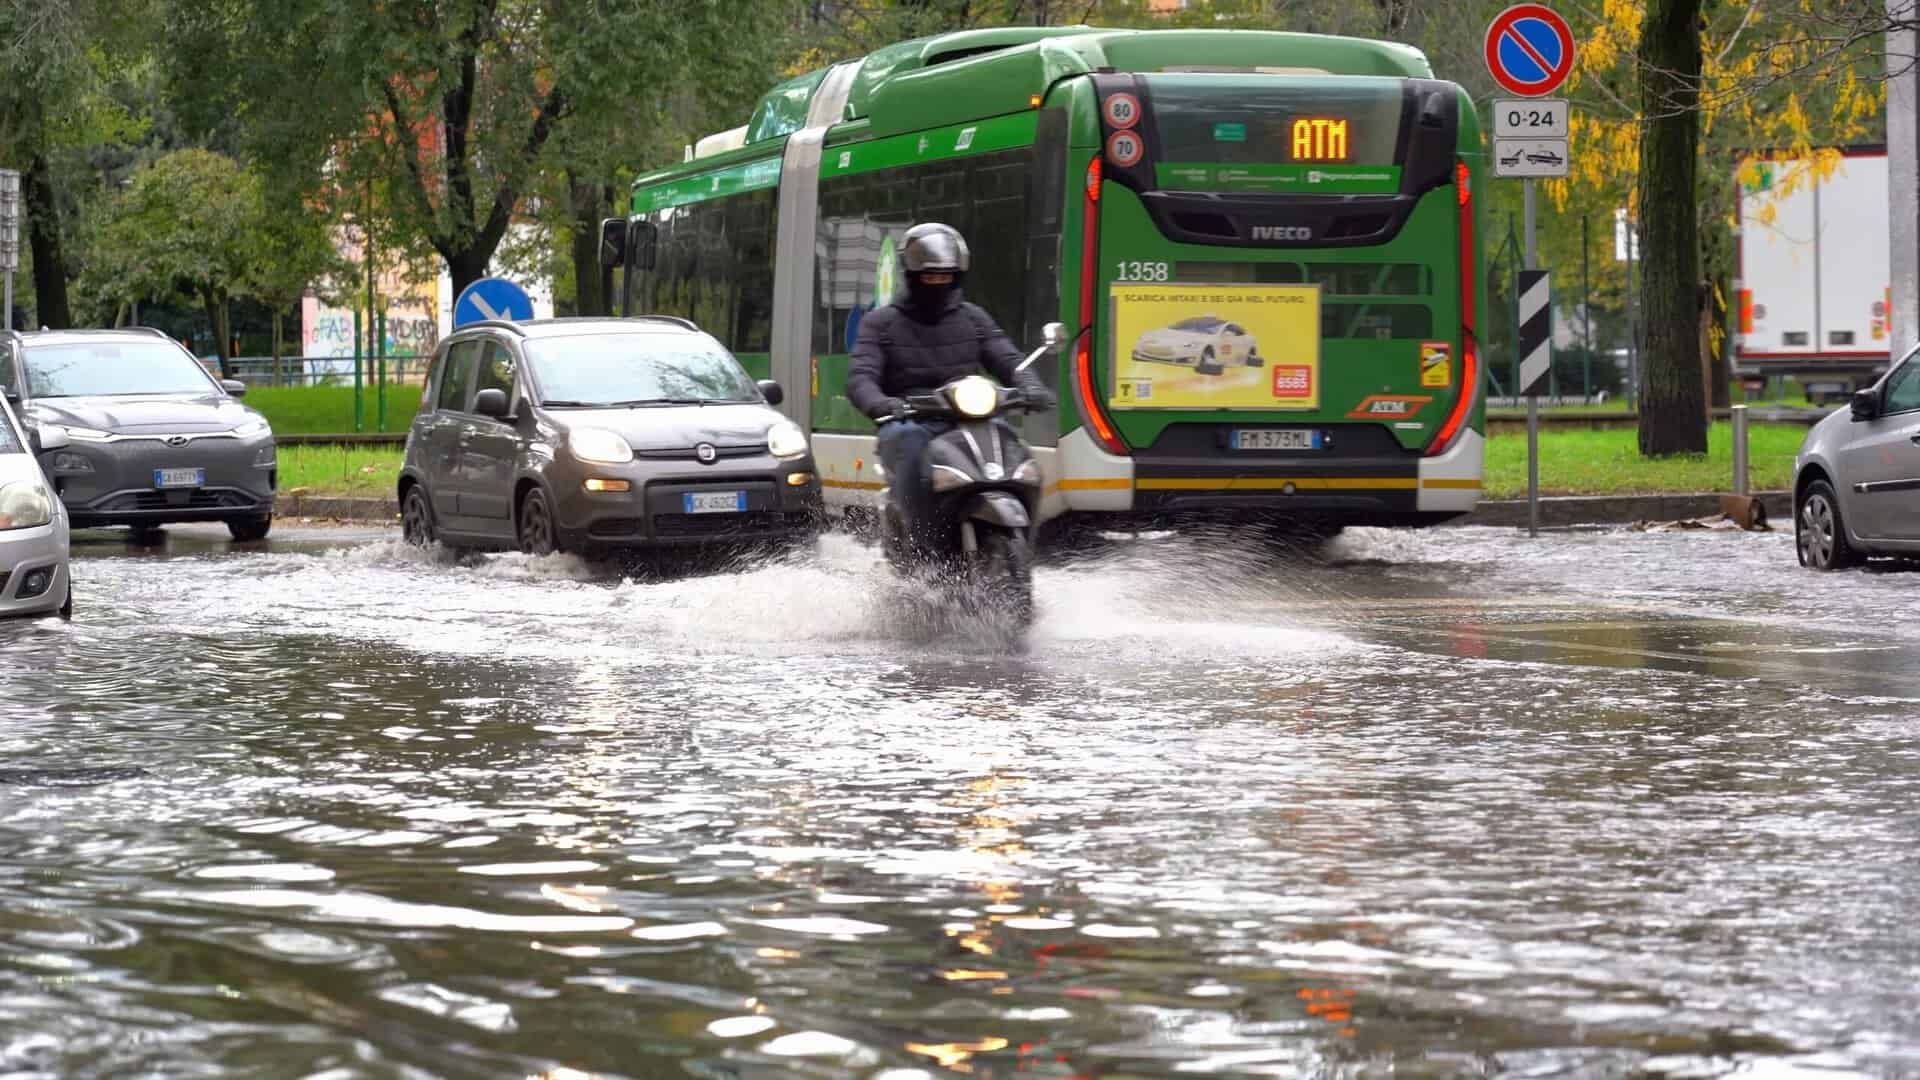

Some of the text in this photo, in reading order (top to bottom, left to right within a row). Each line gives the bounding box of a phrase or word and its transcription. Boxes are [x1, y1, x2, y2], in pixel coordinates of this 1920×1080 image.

[1113, 103, 1131, 118] 80
[1508, 111, 1553, 127] 0-24
[1293, 119, 1346, 159] ATM
[1117, 141, 1133, 155] 70
[1252, 226, 1312, 240] IVECO
[1117, 261, 1169, 281] 1358
[1370, 401, 1406, 413] ATM
[1240, 432, 1311, 448] FM 373ML
